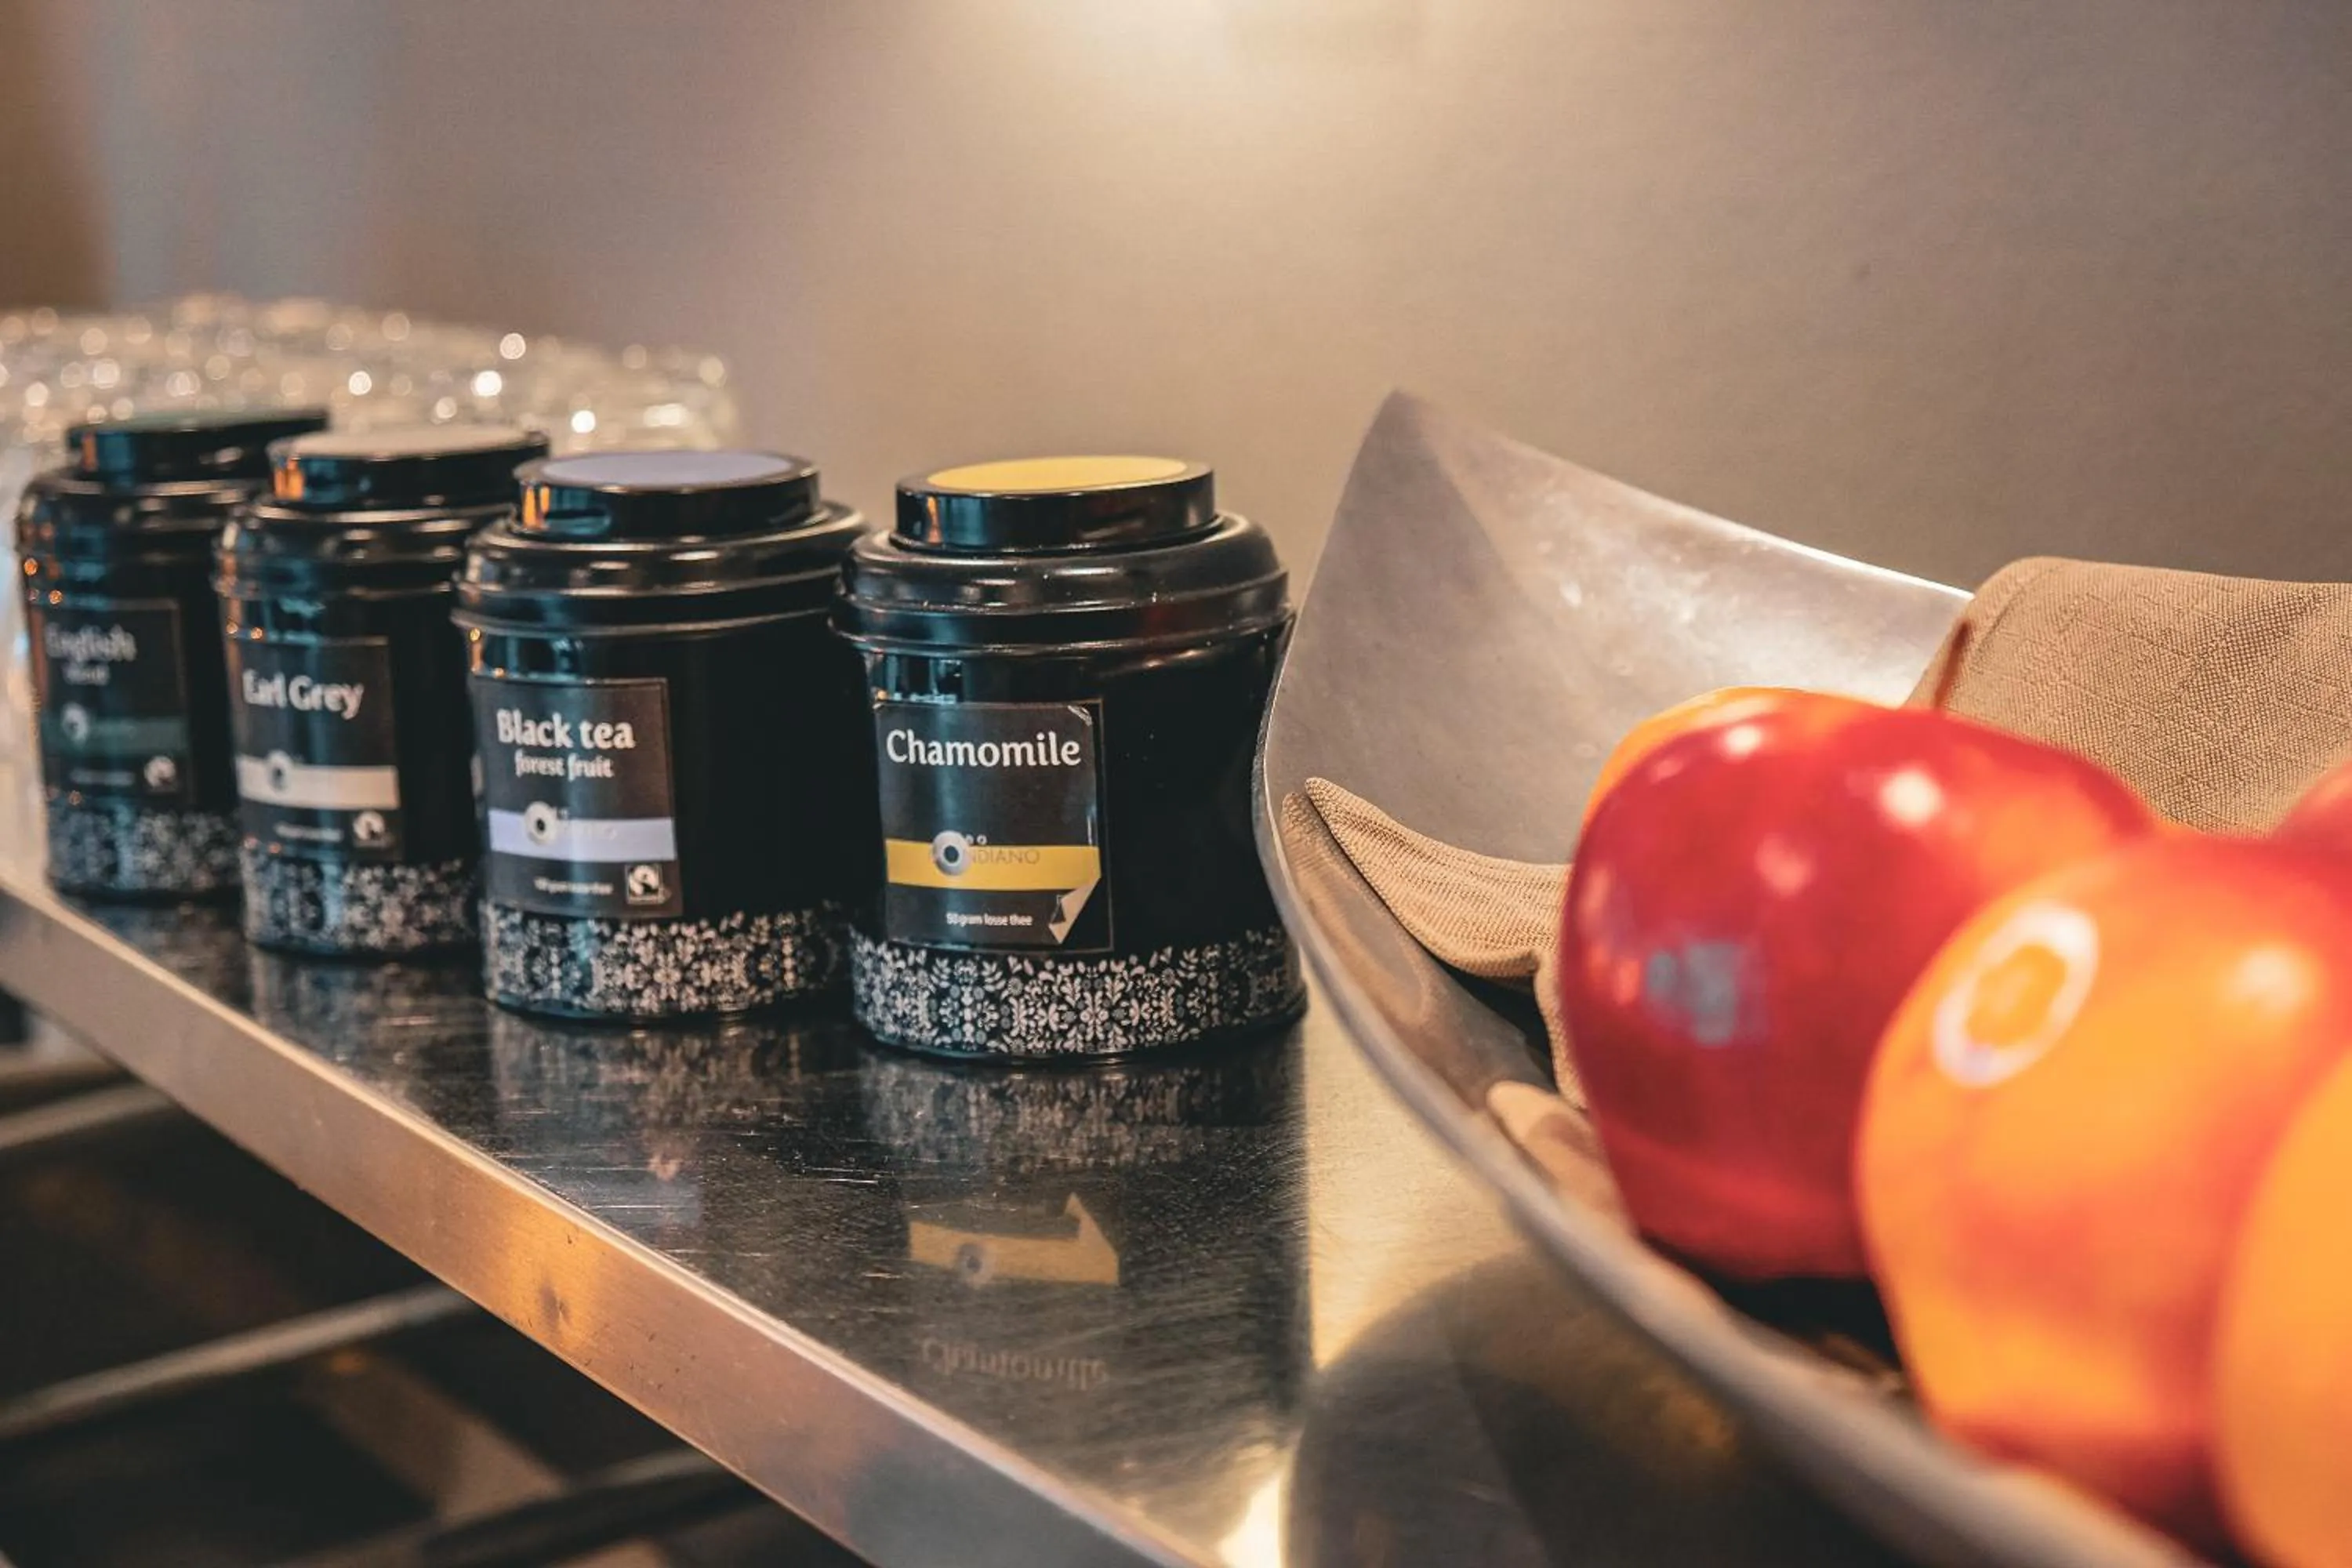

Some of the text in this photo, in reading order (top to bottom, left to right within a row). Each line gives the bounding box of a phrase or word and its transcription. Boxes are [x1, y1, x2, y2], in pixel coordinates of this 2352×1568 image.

[289, 675, 365, 720] Grey
[496, 709, 637, 750] Black tea
[886, 729, 1081, 768] Chamomile
[514, 749, 615, 782] forest fruit
